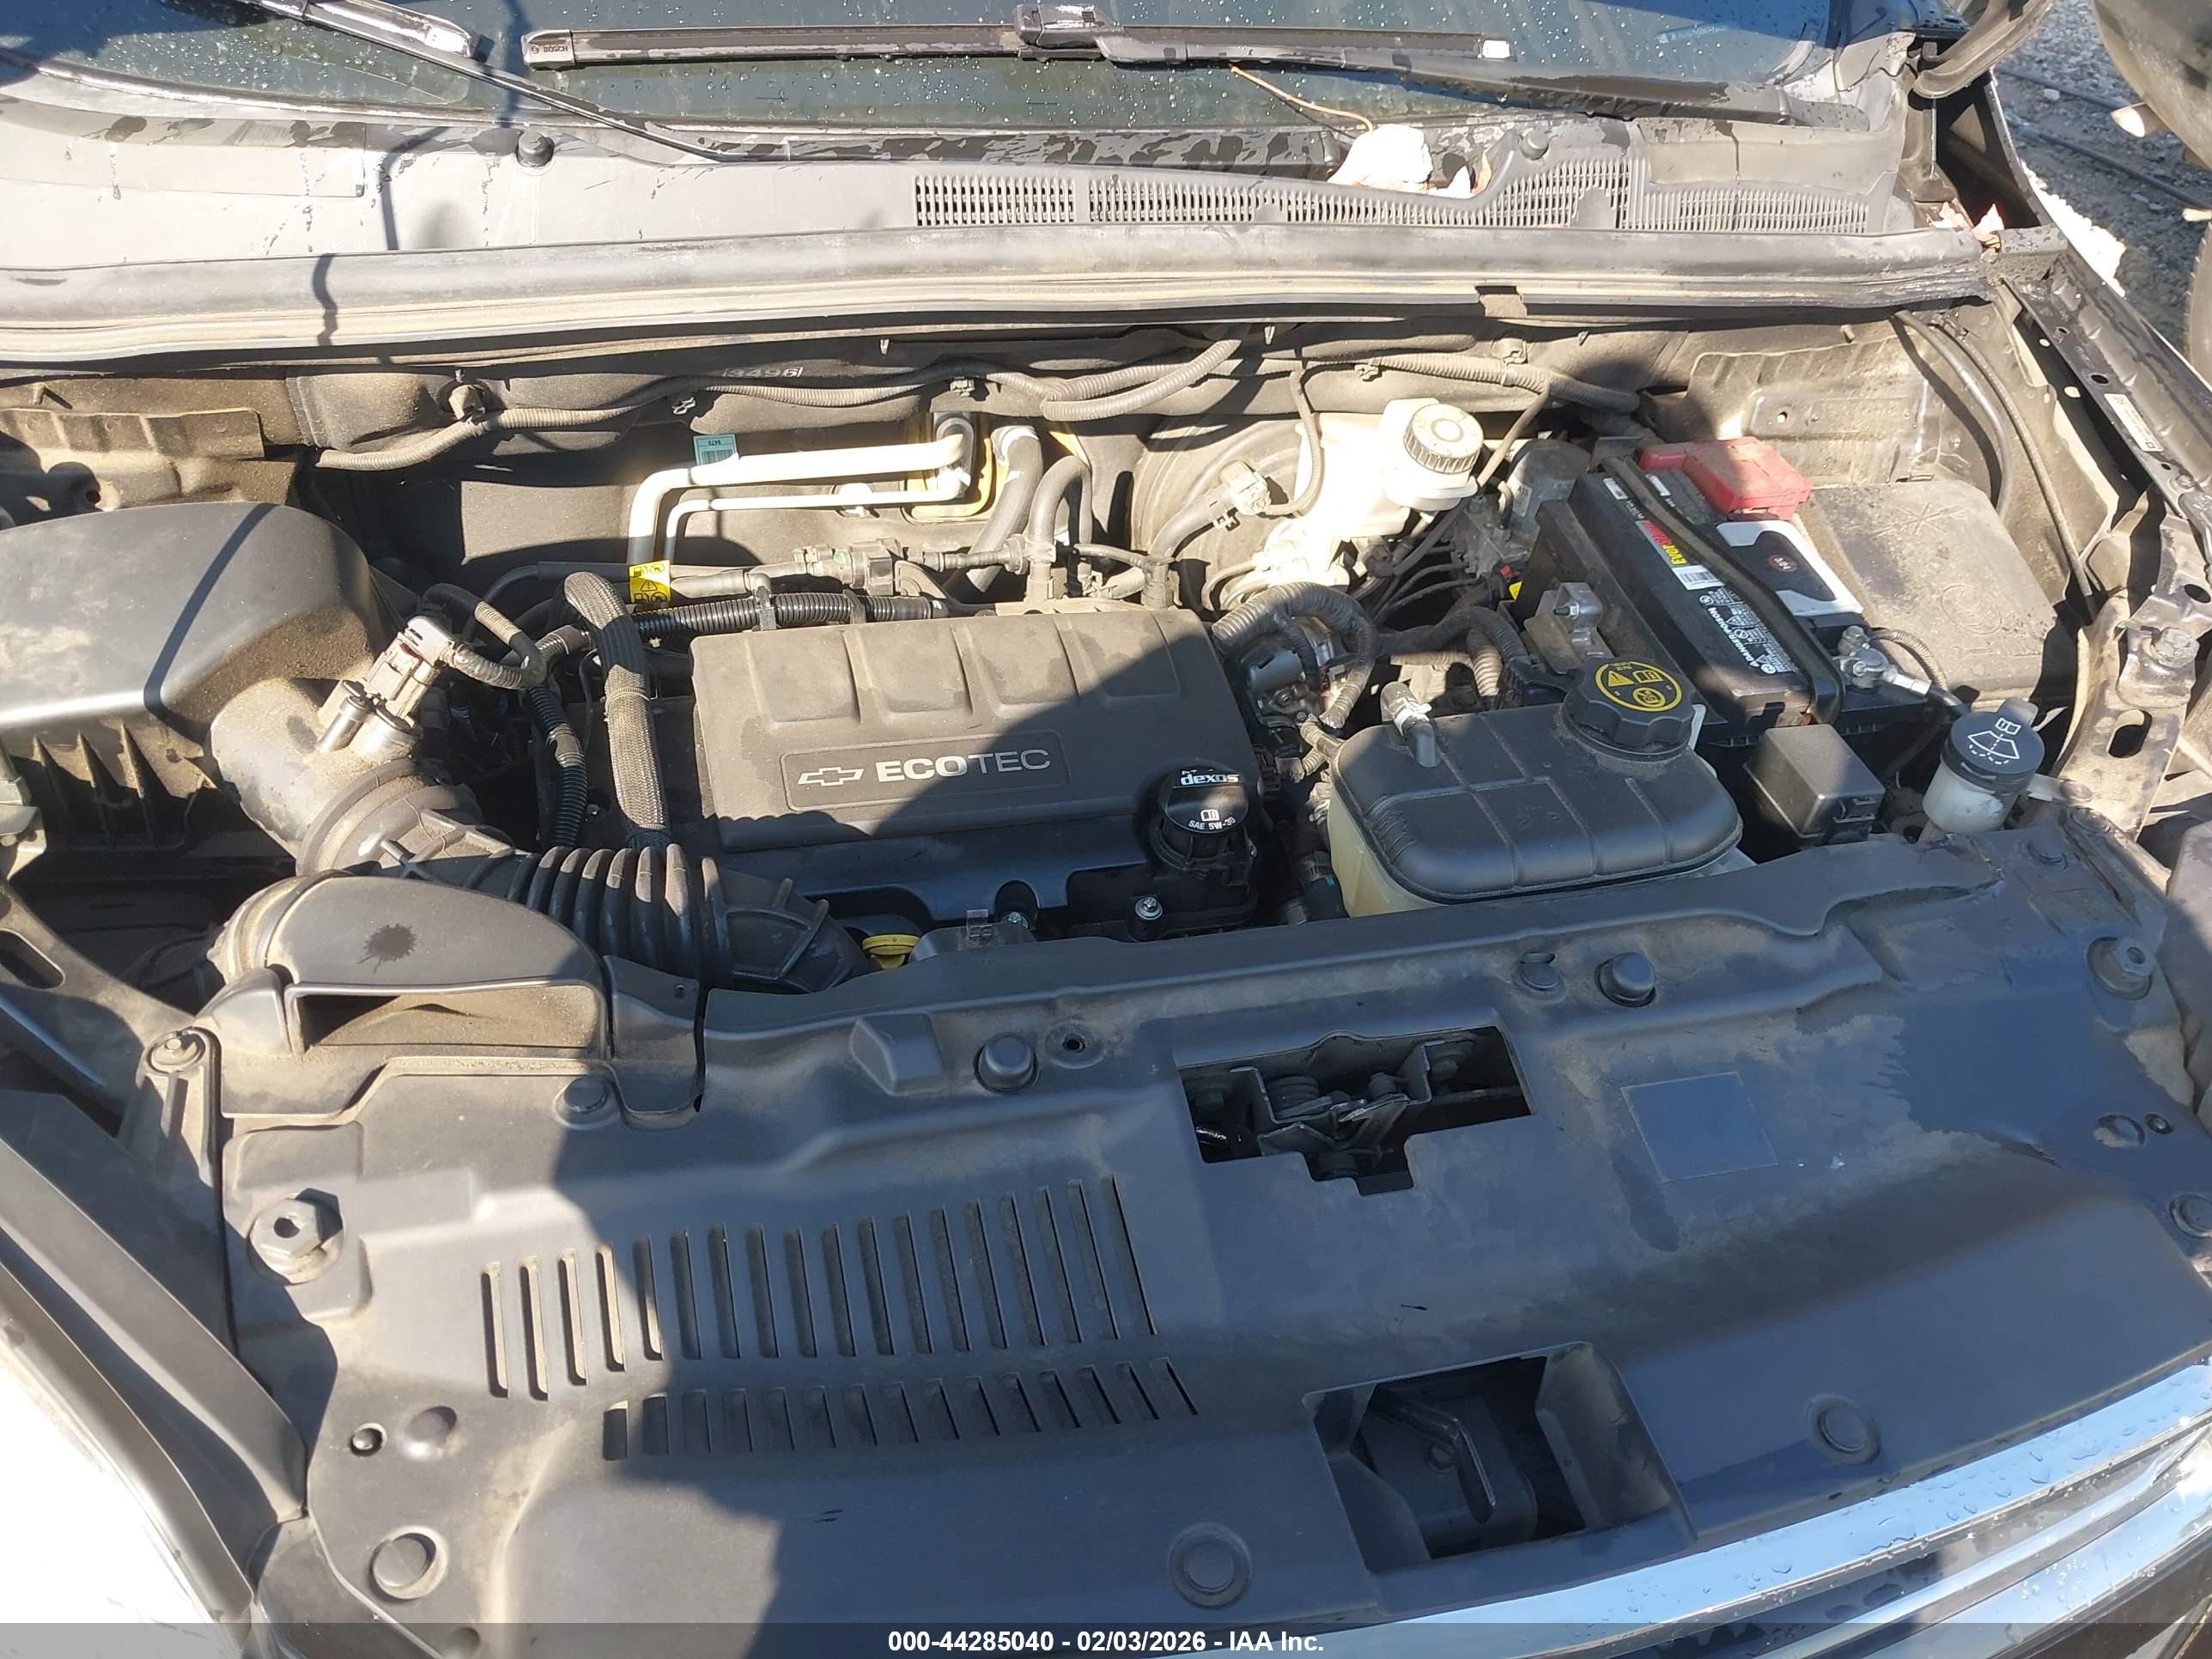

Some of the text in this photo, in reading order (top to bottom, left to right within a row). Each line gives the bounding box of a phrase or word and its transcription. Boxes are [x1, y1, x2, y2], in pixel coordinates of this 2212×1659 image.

[874, 748, 1051, 783] ECOTEC
[1180, 773, 1241, 786] dexos
[1188, 817, 1237, 830] SAE 5W-30
